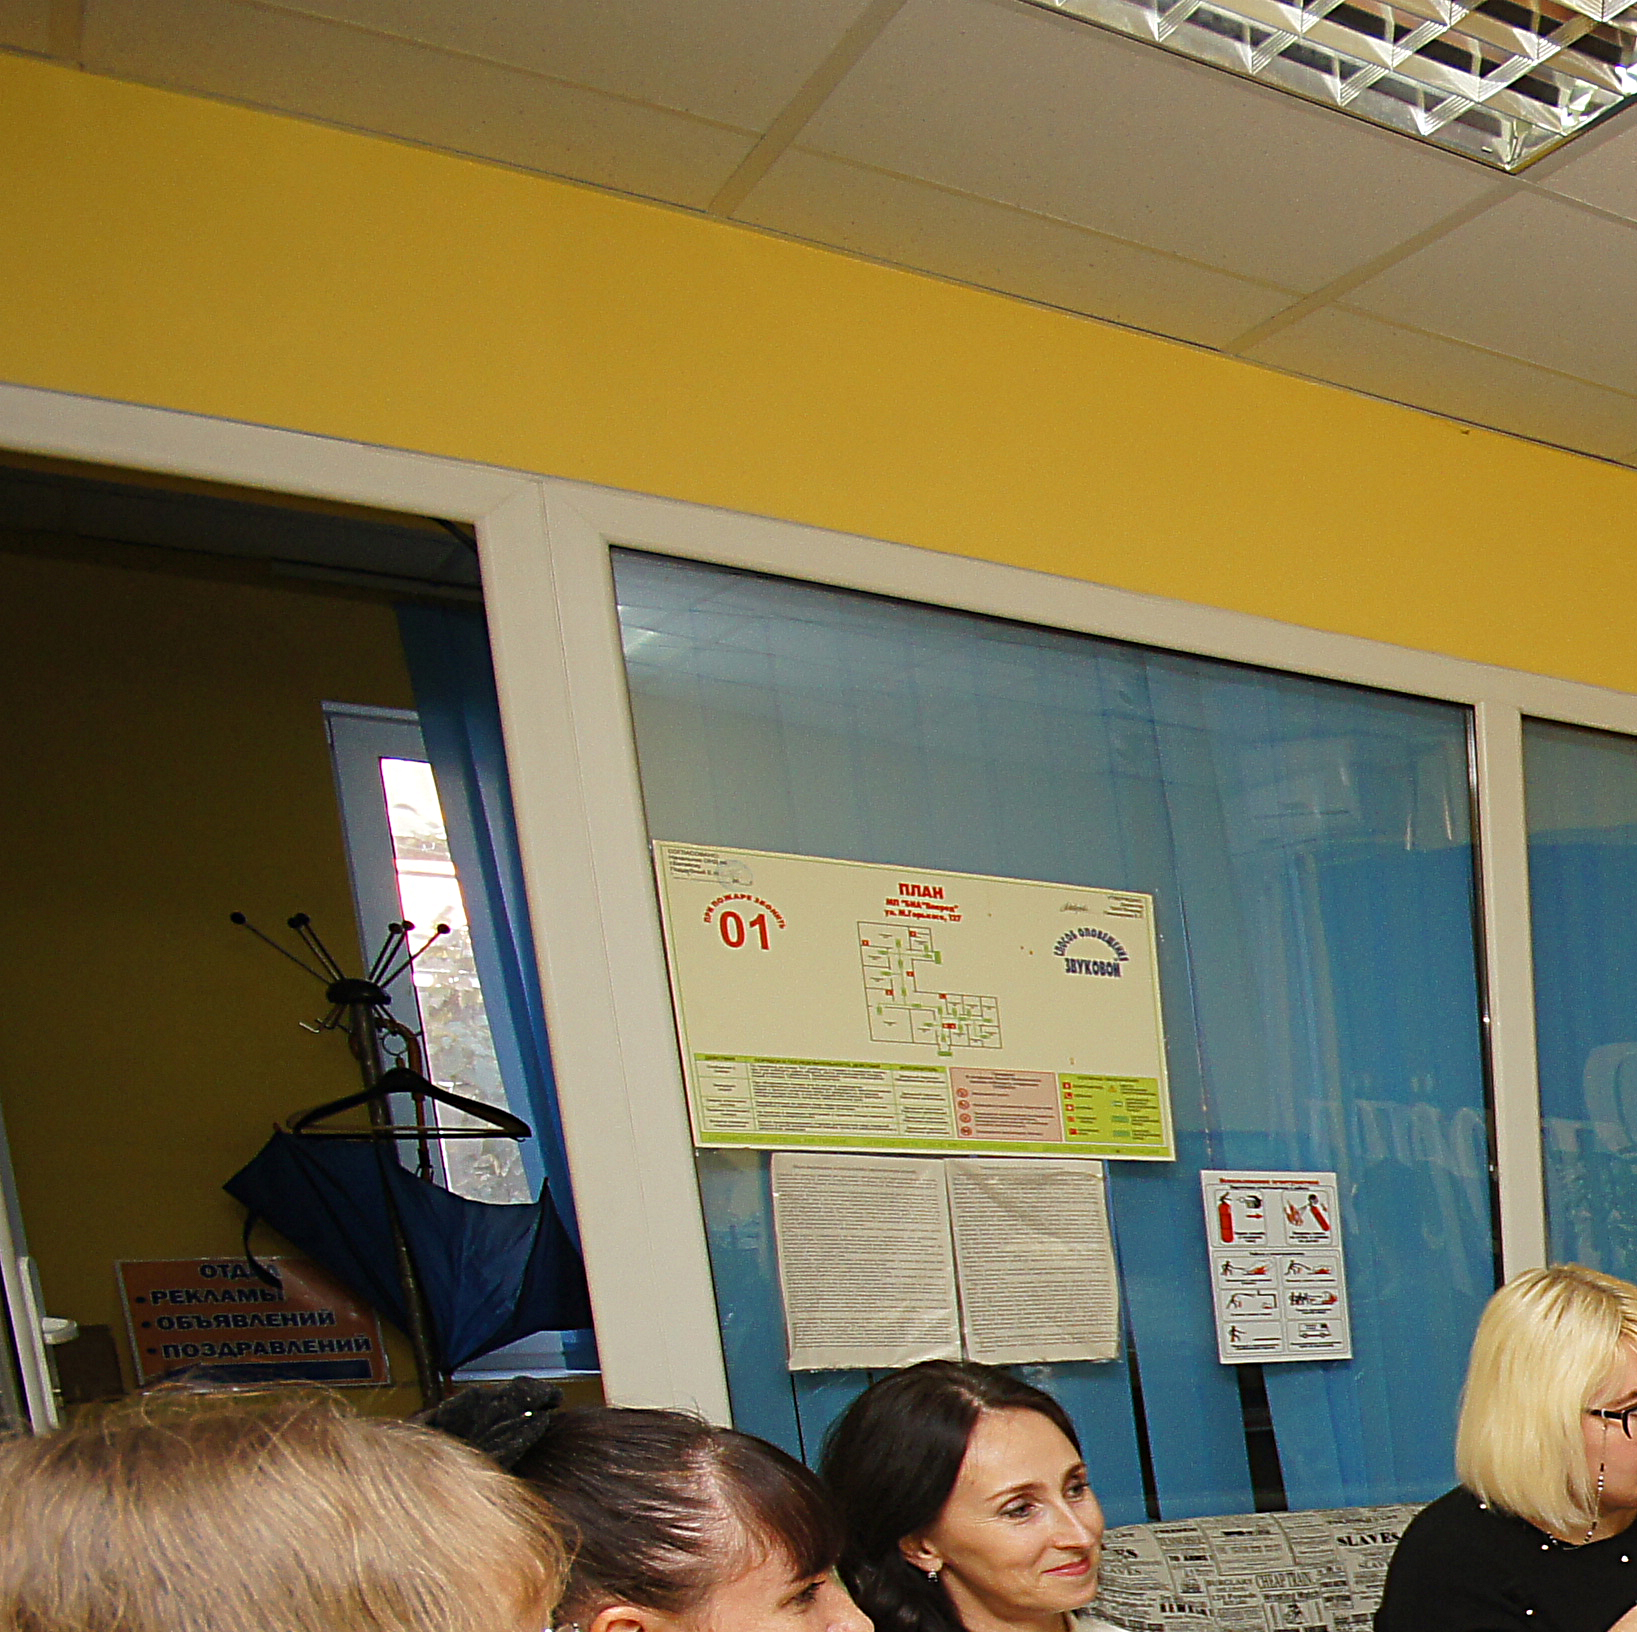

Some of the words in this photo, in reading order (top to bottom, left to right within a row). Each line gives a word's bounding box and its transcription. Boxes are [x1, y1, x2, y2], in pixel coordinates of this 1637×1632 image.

[899, 883, 944, 899] ПЛАН
[704, 904, 715, 923] ПРИ
[711, 893, 753, 908] ПОЖАРЕ
[753, 897, 787, 929] ЗВОНИТЬ
[719, 910, 770, 951] 01
[1064, 956, 1121, 978] ЗВУКОВОЙ
[149, 1287, 286, 1305] РЕКЛАМЫ
[155, 1308, 337, 1331] ОБЪЯВЛЕНИЙ
[162, 1333, 373, 1359] ПОЗДРАВЛЕНИЙ
